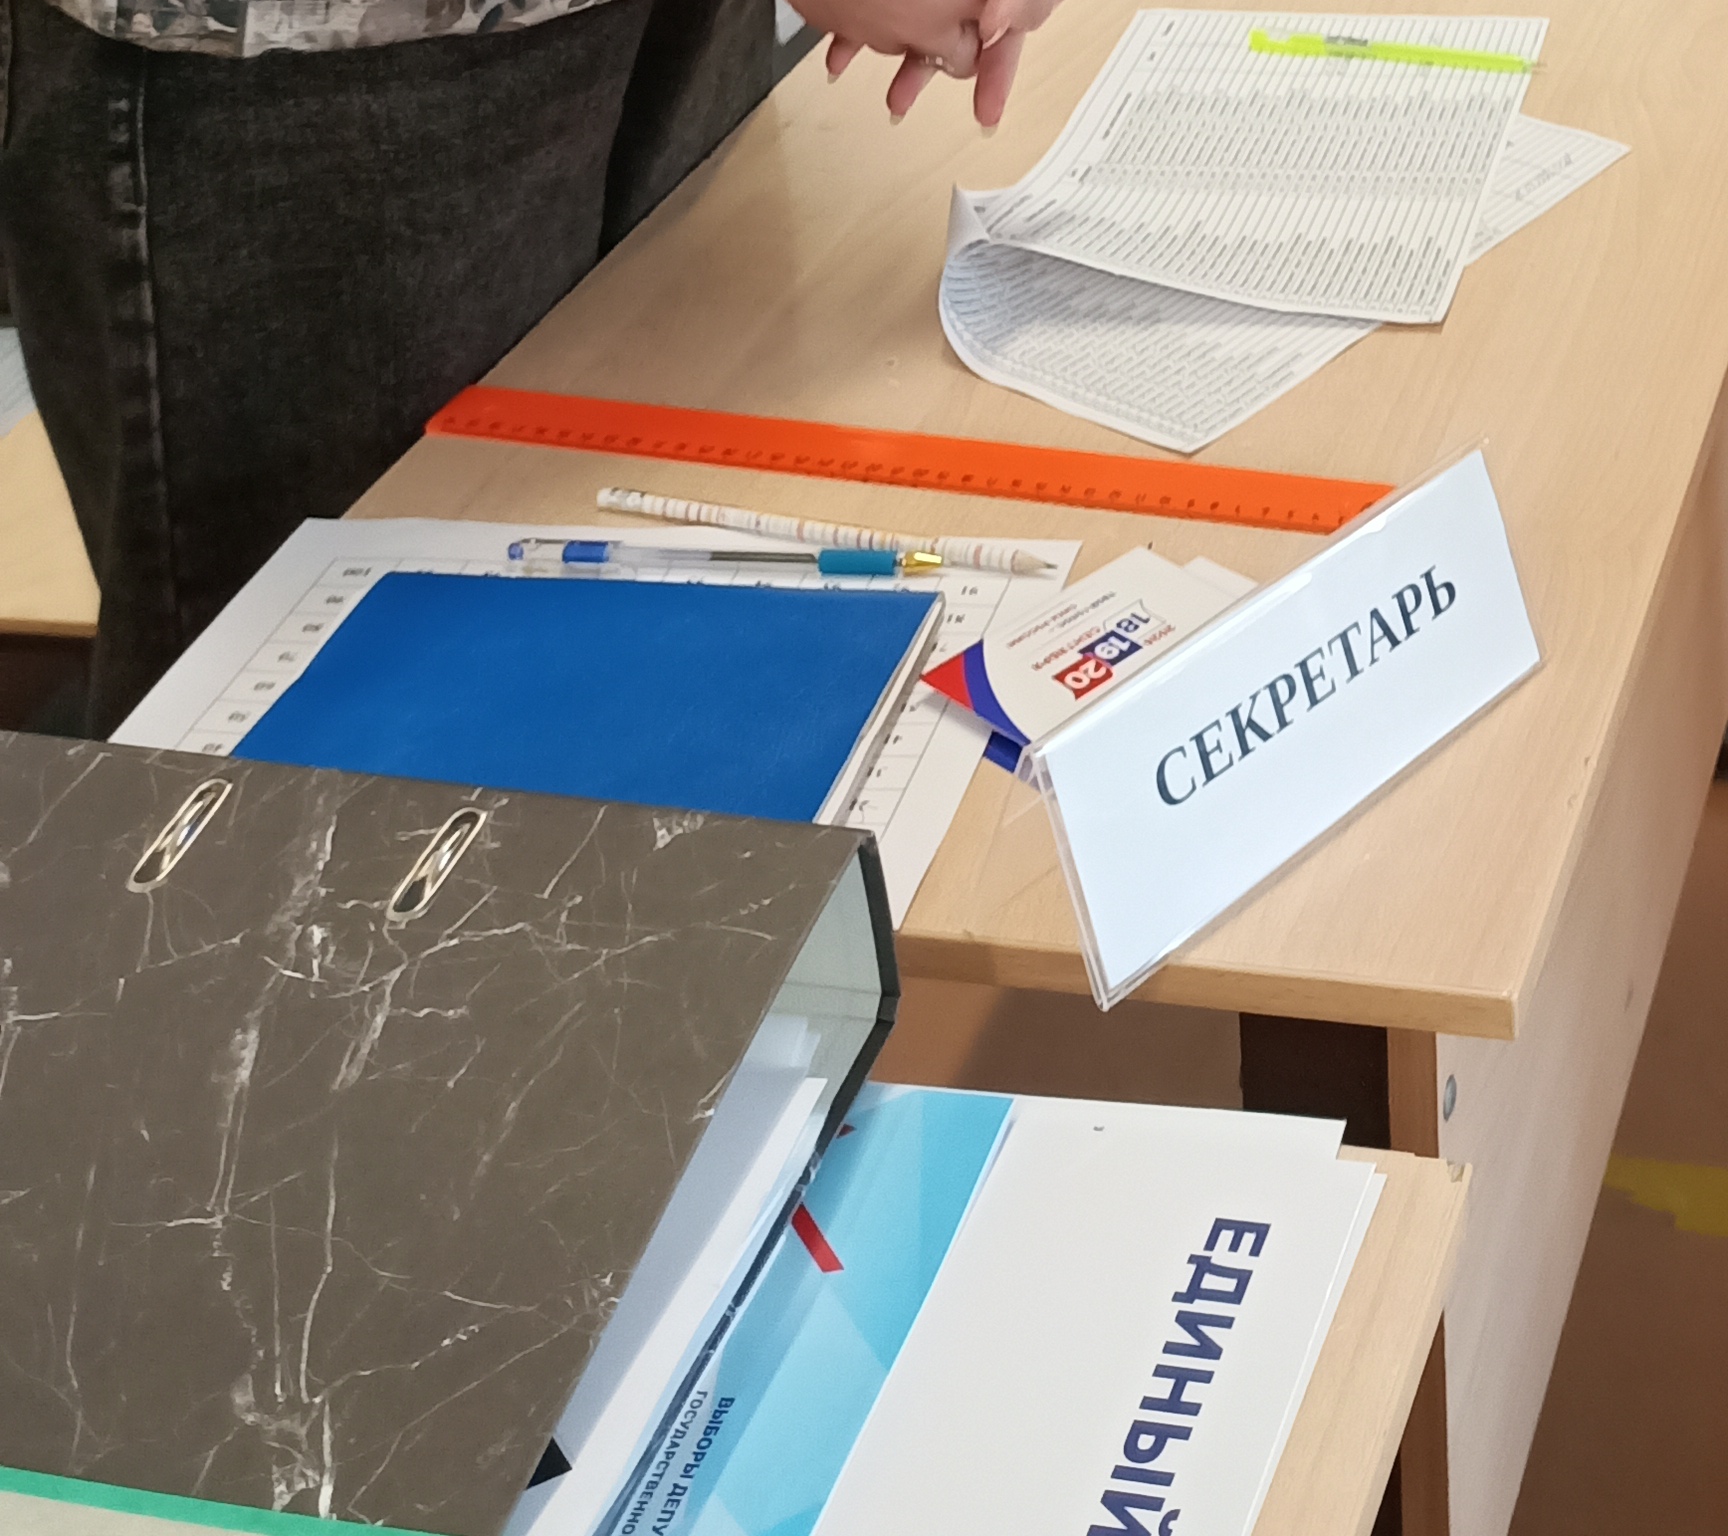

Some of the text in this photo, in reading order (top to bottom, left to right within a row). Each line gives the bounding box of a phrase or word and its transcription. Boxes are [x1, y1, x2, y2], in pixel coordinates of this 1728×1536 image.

[1064, 659, 1108, 689] 20
[1094, 635, 1131, 660] 19
[1116, 612, 1151, 633] 18
[1155, 564, 1458, 806] СЕКРЕТАРЬ
[1086, 1216, 1273, 1536] ЕДИНЫЙ
[622, 1390, 708, 1535] ГОСУДАРСТВЕННО
[652, 1397, 735, 1536] ВЫБОРЫ ДЕПУ
